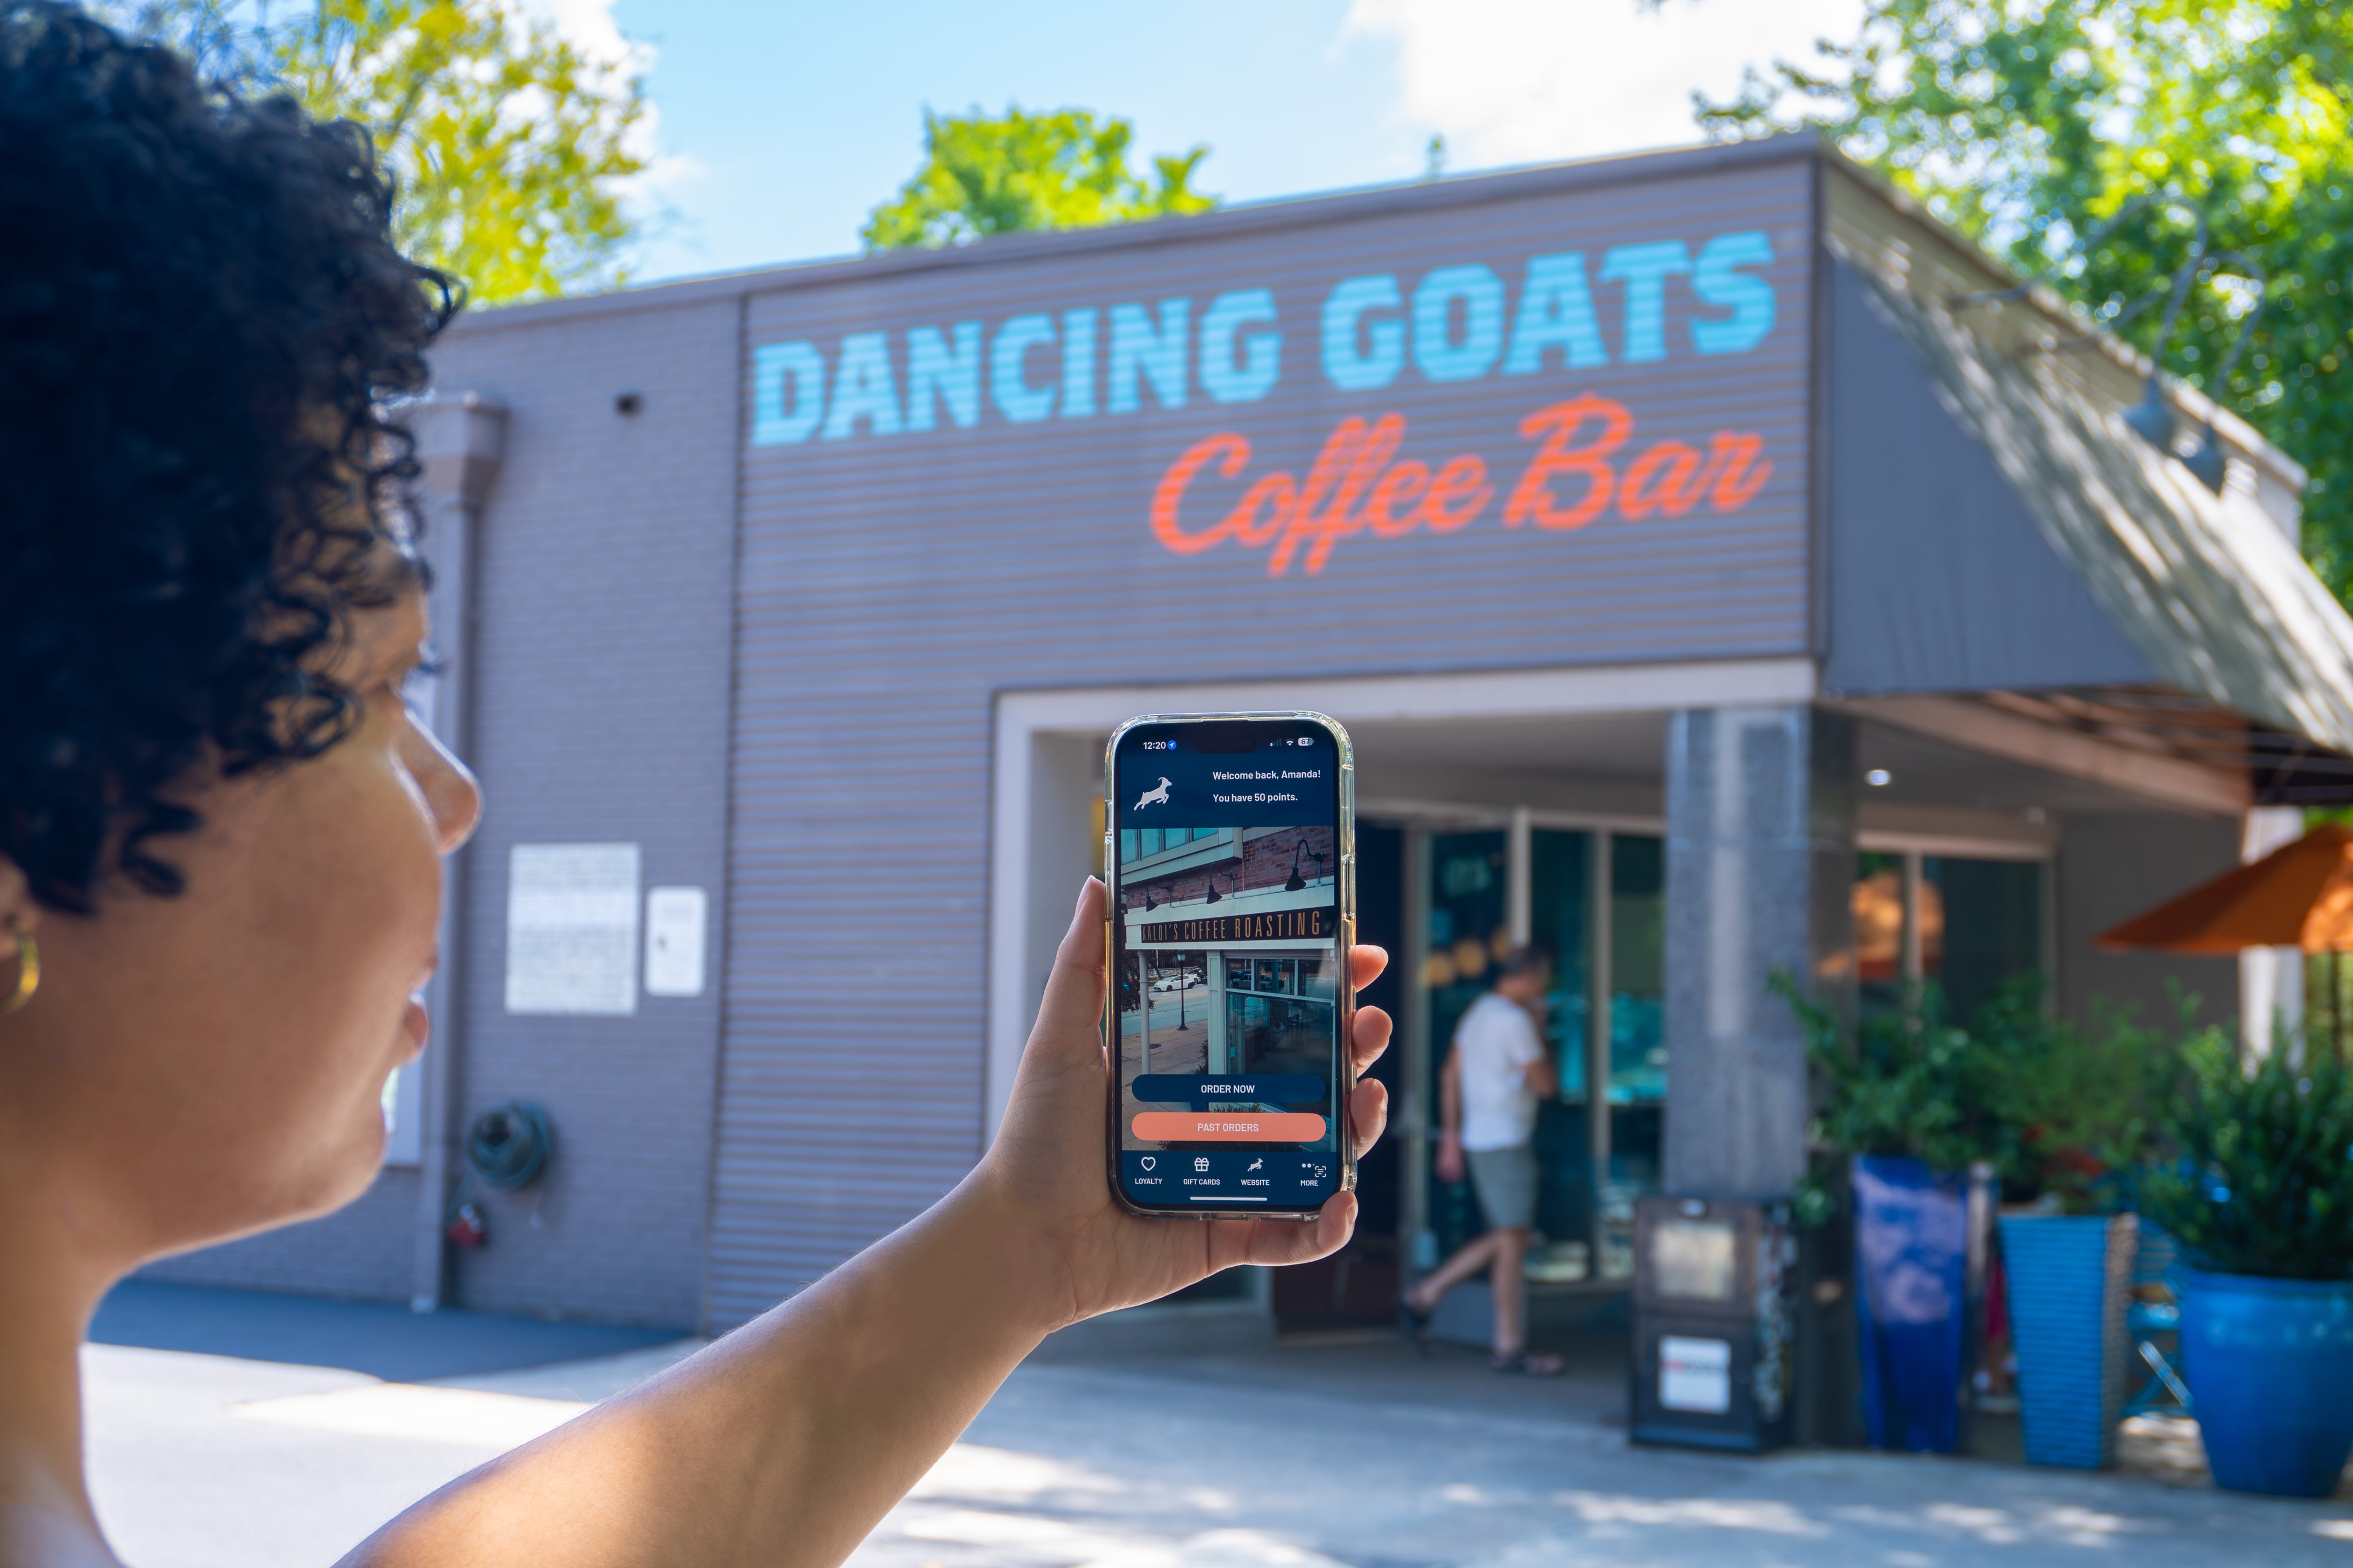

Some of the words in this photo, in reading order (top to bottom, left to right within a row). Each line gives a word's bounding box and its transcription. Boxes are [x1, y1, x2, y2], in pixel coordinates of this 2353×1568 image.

[751, 286, 1280, 448] DANCING
[1321, 229, 1777, 391] GOATS
[1150, 411, 1494, 578] Coffee
[1502, 391, 1773, 531] Bar
[1213, 771, 1253, 780] Welcome
[1255, 771, 1279, 780] back,
[1282, 769, 1321, 779] Amanda!
[1213, 794, 1229, 802] You
[1231, 793, 1252, 802] have
[1254, 793, 1265, 801] 50
[1268, 793, 1298, 803] points.
[1142, 924, 1178, 941] KALDI'S
[1185, 919, 1226, 940] COFFEE
[1234, 911, 1321, 939] ROASTING
[1201, 1085, 1231, 1094] ORDER
[1233, 1085, 1255, 1094] NOW
[1198, 1123, 1220, 1132] PAST
[1222, 1123, 1259, 1132] ORDERS
